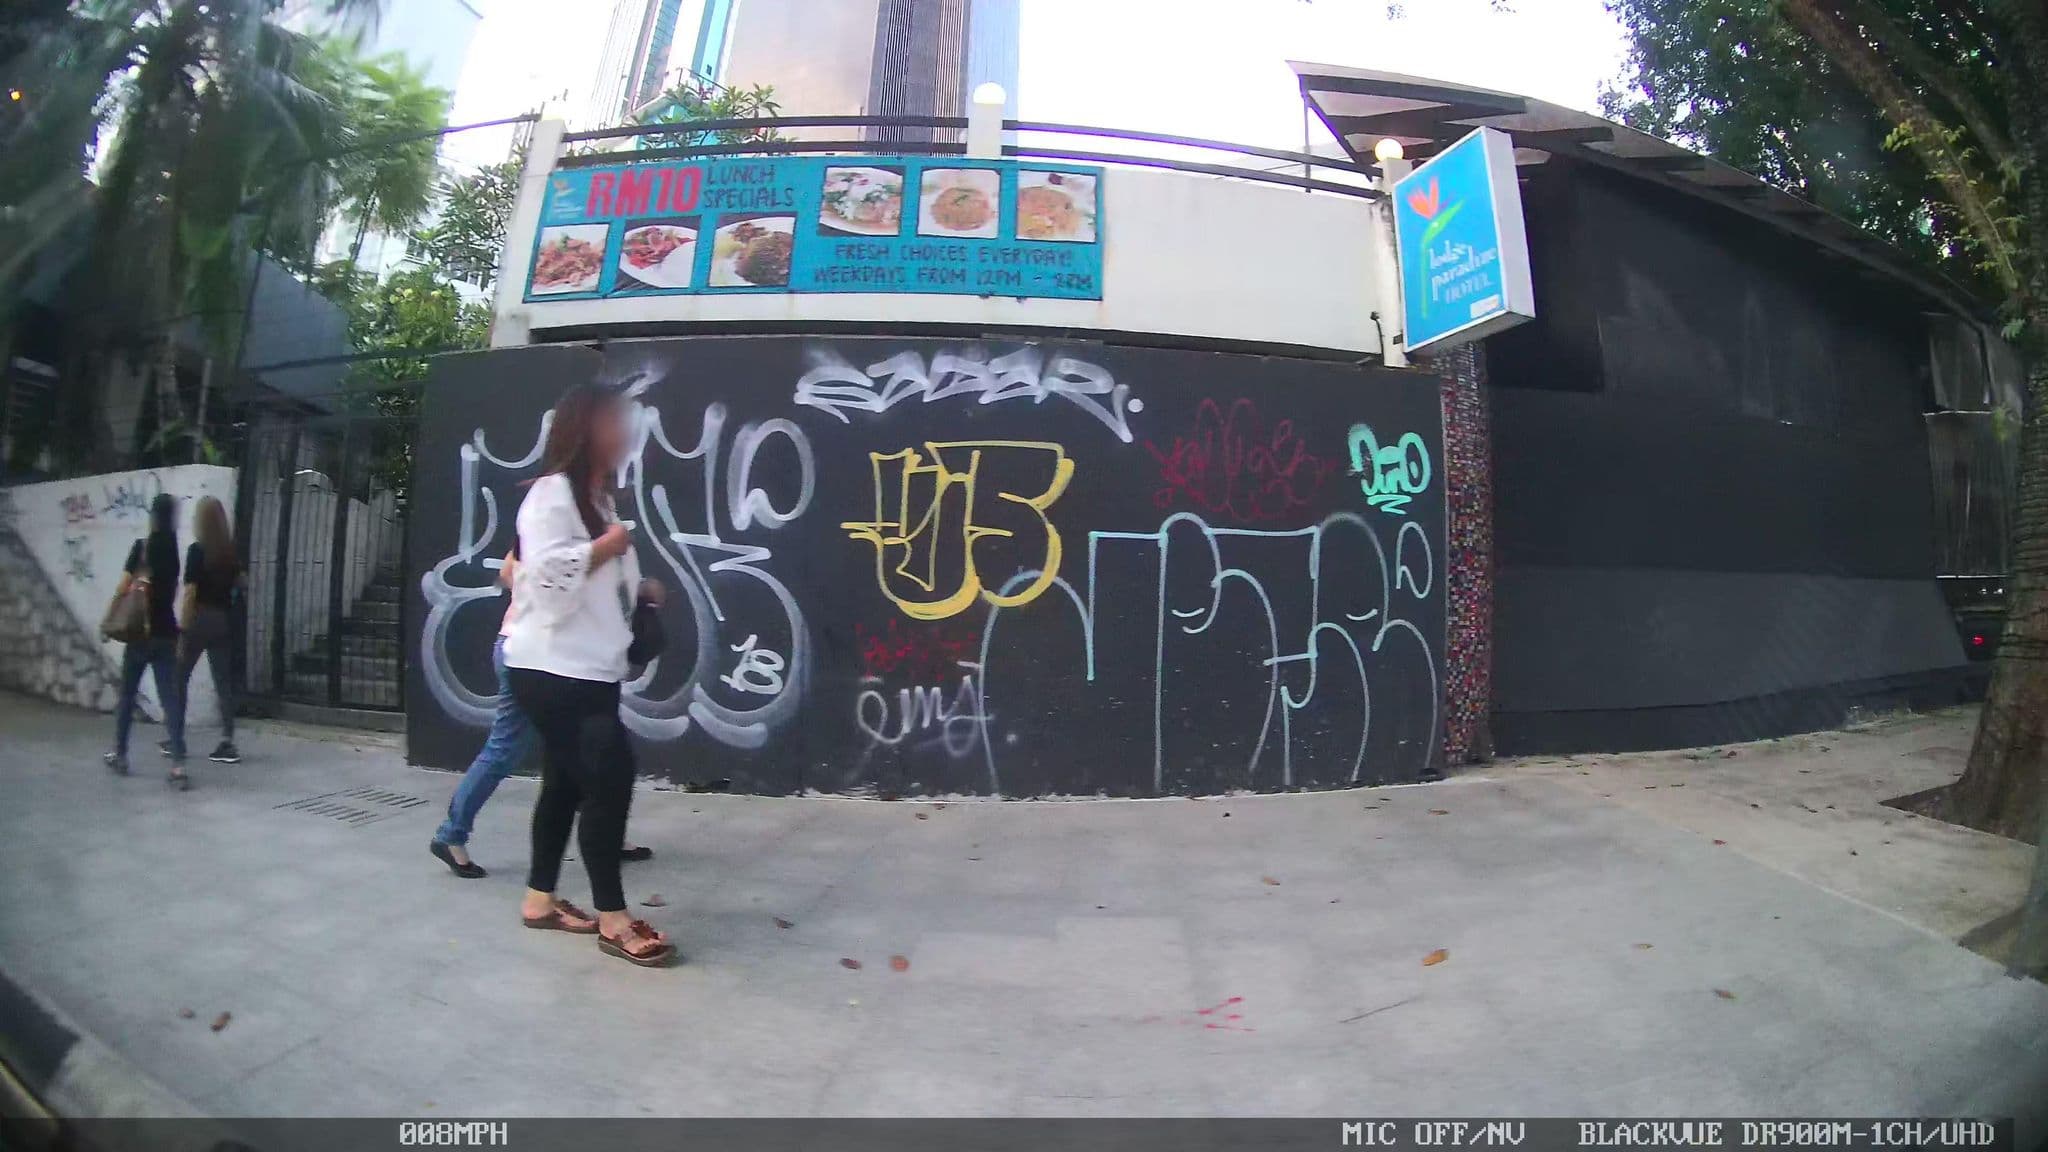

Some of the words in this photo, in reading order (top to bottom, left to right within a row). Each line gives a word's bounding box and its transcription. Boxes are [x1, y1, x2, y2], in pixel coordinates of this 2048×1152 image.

[705, 163, 775, 186] LUNCH
[584, 165, 704, 218] RM10
[703, 186, 795, 209] SPECIALS
[835, 244, 890, 261] FRESH
[901, 245, 968, 262] CHOICES
[814, 264, 905, 284] WEEKDAYS
[917, 267, 967, 285] FROM
